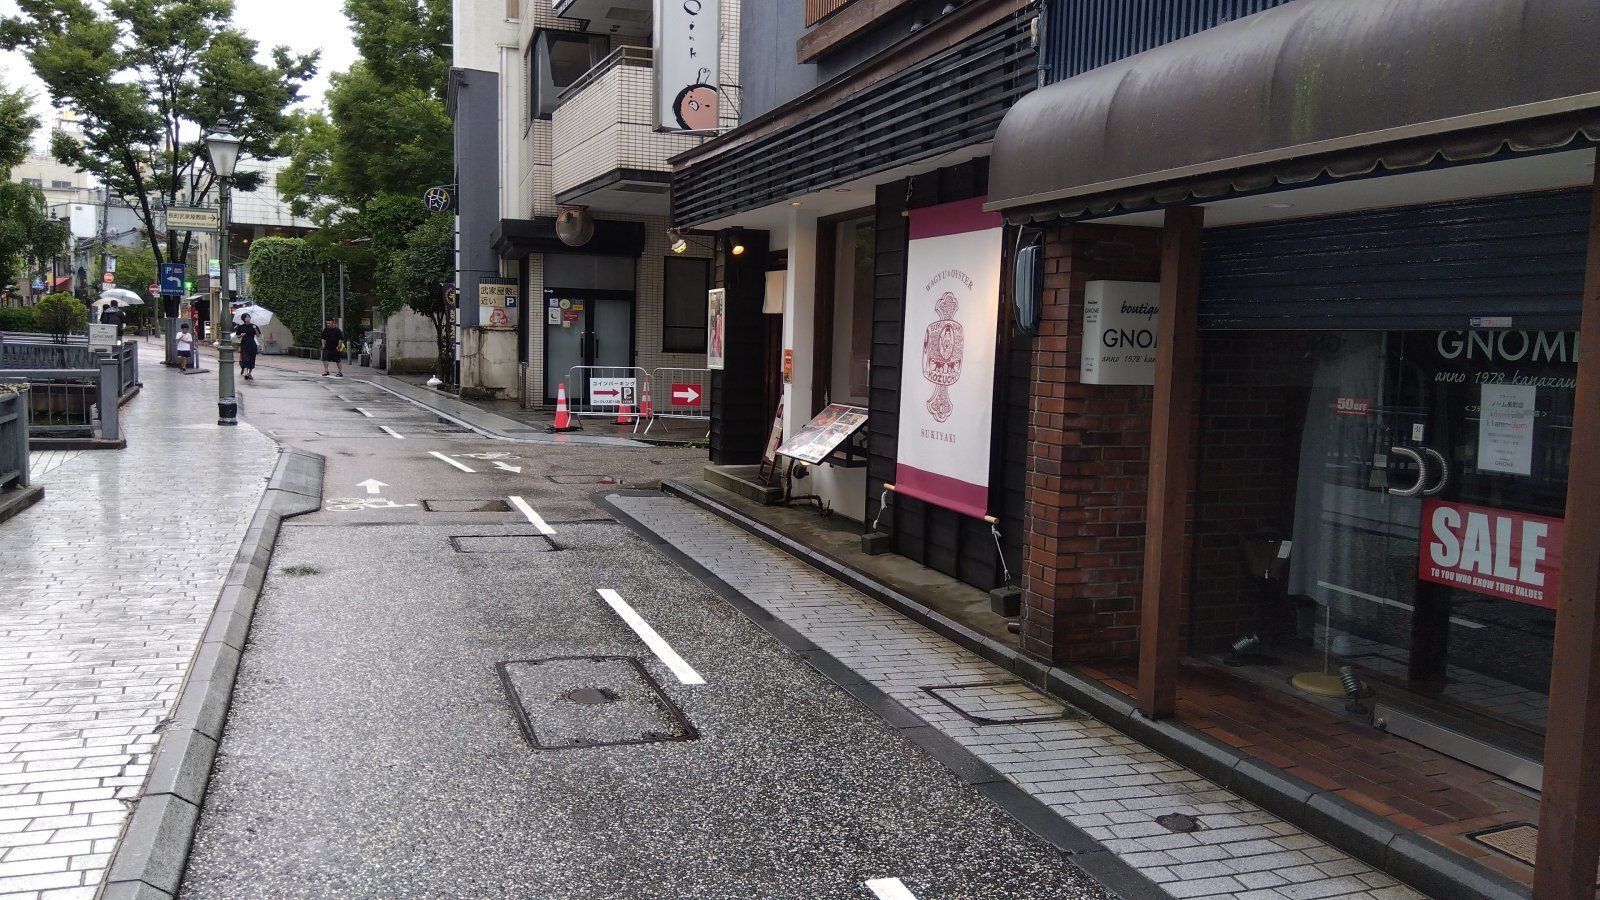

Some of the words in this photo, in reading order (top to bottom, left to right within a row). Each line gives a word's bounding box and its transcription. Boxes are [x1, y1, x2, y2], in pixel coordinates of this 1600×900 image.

[480, 296, 497, 306] 近い
[506, 297, 515, 306] P
[1102, 328, 1158, 349] GNO
[1101, 355, 1120, 363] anno
[1124, 355, 1141, 363] 1978
[1435, 371, 1466, 383] anno
[1474, 371, 1506, 385] 1978
[920, 429, 956, 444] SUKIYAKI
[1430, 506, 1548, 587] SALE
[1431, 567, 1440, 578] TO
[1441, 569, 1455, 581] YOU
[1455, 573, 1472, 585] WHO
[1472, 576, 1495, 590] KNOW
[1495, 581, 1514, 595] TRUE
[1515, 585, 1543, 601] VALUES
